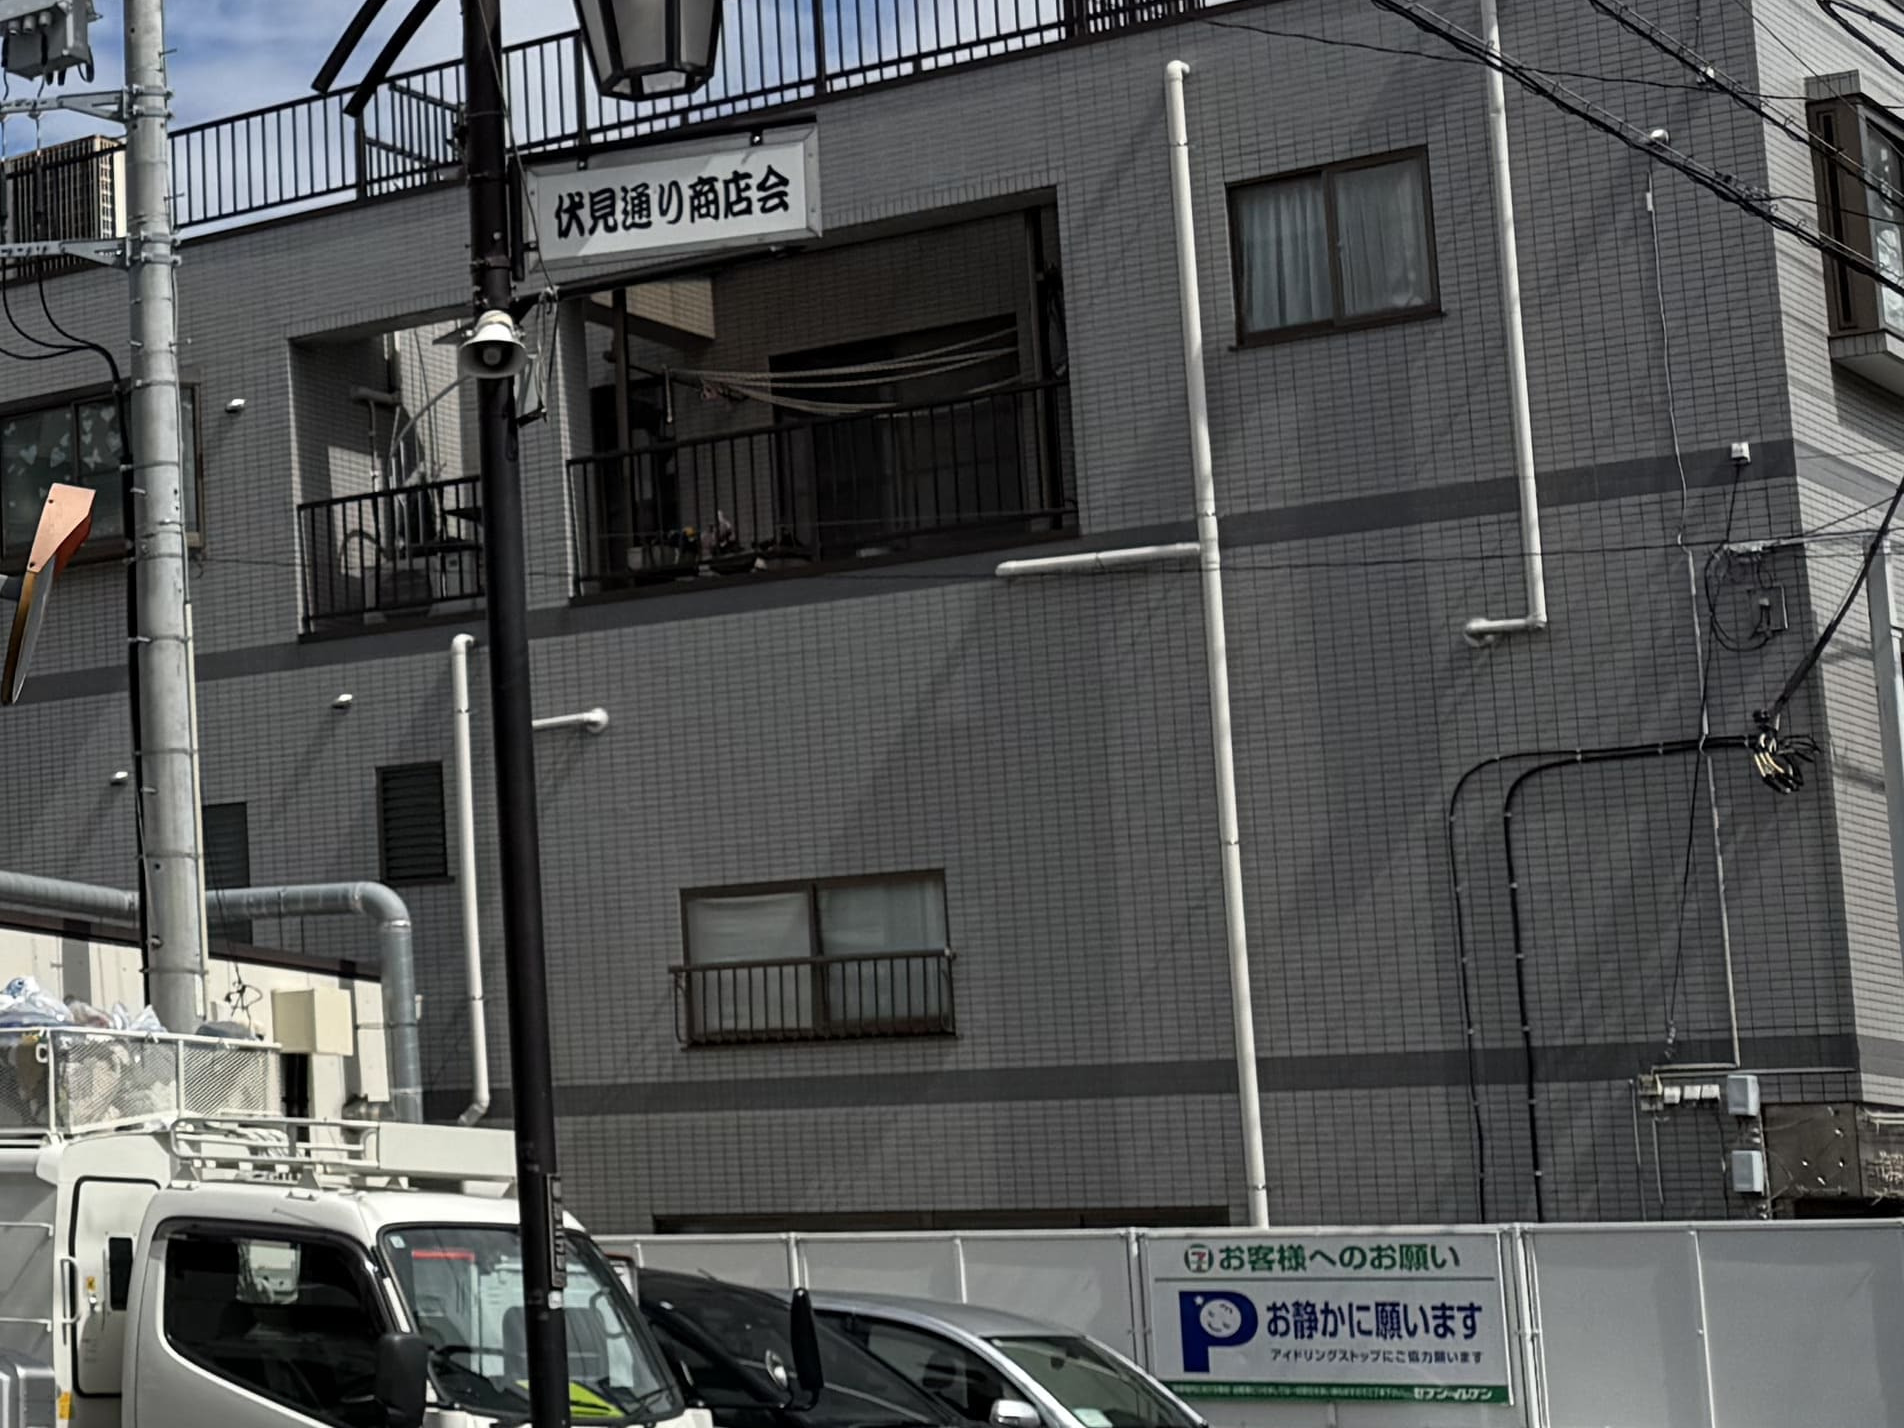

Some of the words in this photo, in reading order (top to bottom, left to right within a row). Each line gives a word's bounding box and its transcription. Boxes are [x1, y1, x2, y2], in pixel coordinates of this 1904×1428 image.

[554, 164, 790, 239] 伏見通り商店会
[1219, 1243, 1461, 1272] お客様へのお願い
[1178, 1290, 1259, 1372] P
[1266, 1300, 1483, 1340] お静かに願います
